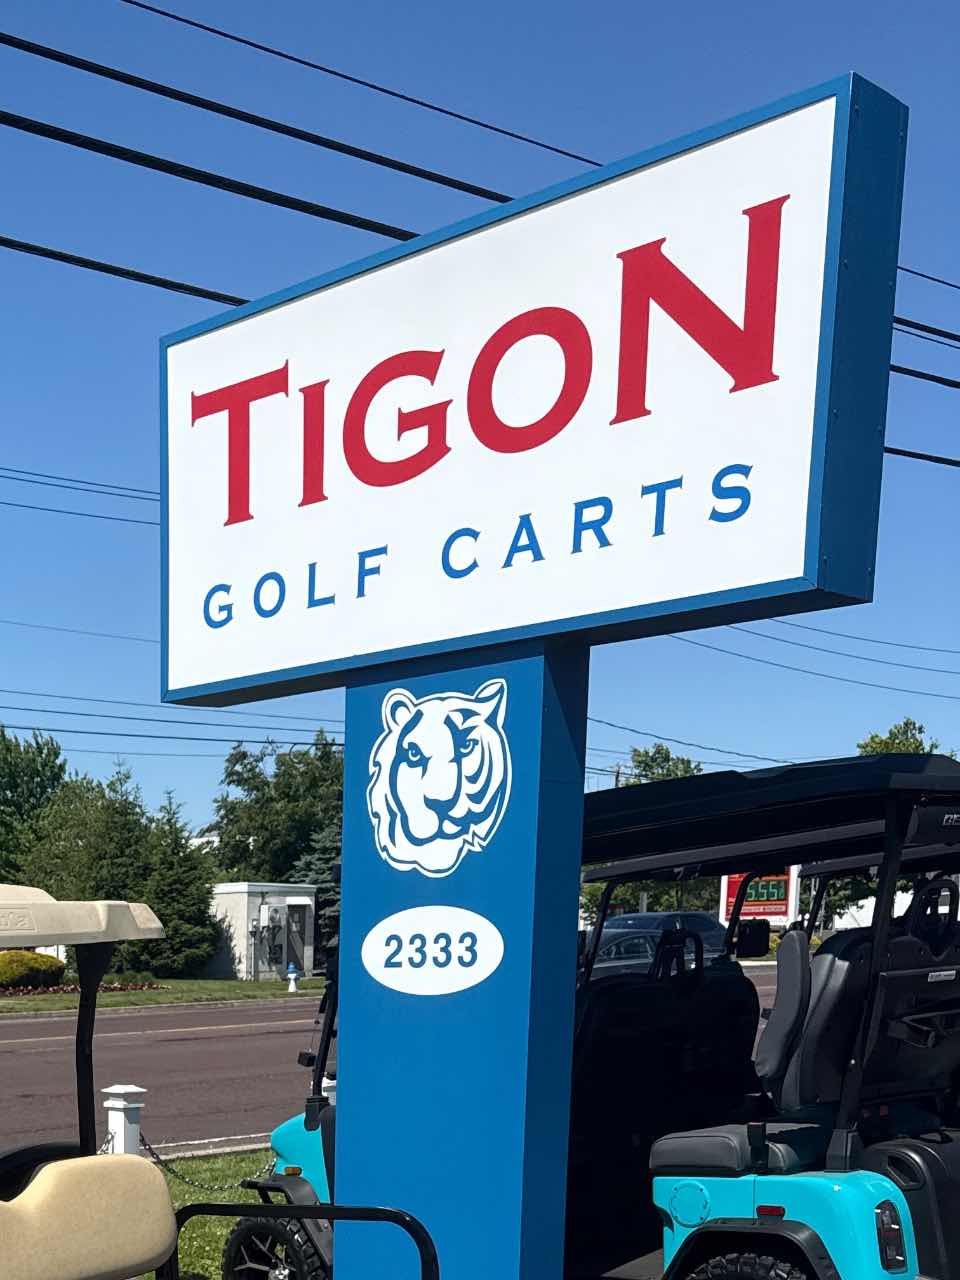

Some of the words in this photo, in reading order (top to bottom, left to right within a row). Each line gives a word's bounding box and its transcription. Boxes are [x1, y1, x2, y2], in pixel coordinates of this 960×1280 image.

[191, 194, 791, 527] TIGON
[203, 545, 389, 629] GOLF
[441, 464, 754, 580] CARTS
[384, 931, 478, 969] 2333
